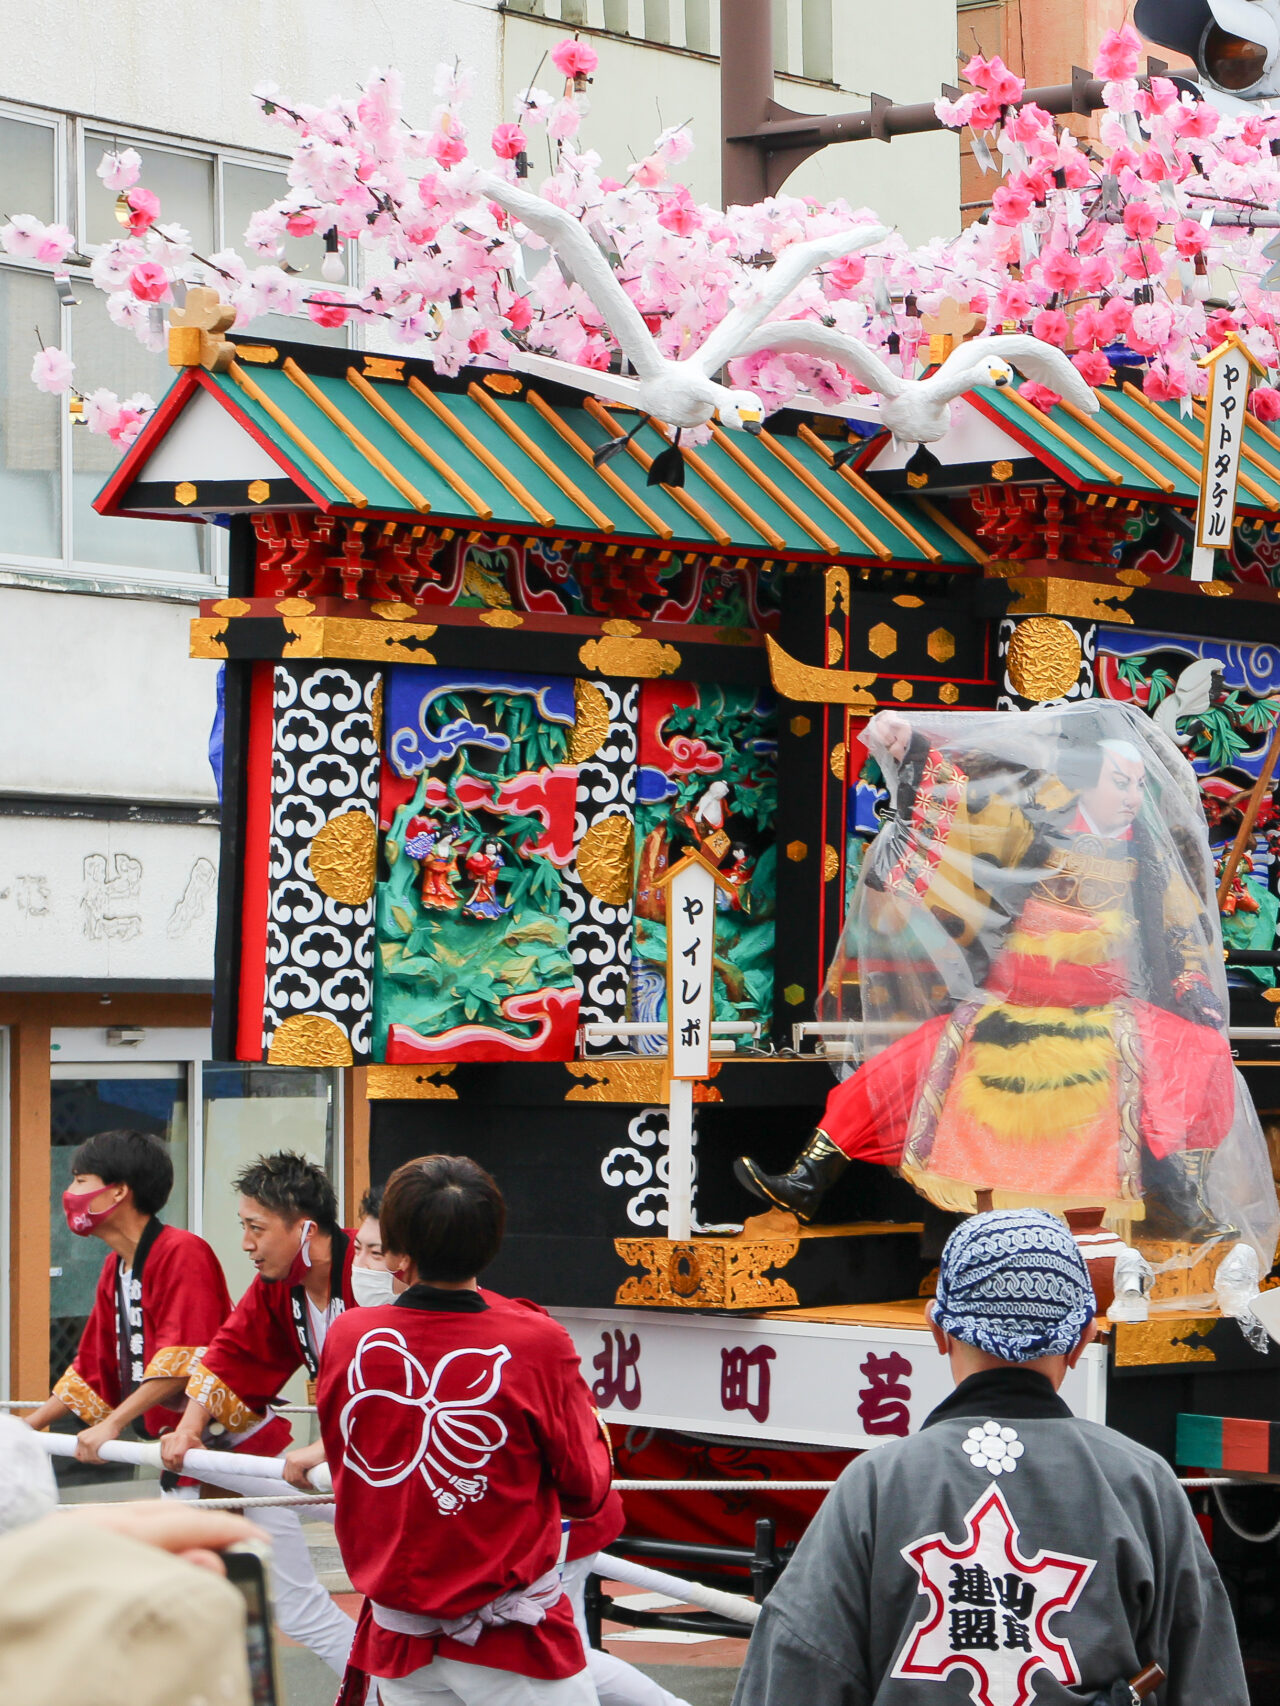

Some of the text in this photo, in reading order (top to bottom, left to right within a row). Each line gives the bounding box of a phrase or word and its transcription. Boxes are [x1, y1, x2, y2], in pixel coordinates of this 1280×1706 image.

[1208, 364, 1239, 537] ヤマトタケル
[681, 895, 704, 1049] ヤイレポ
[947, 1562, 1000, 1652] 連盟
